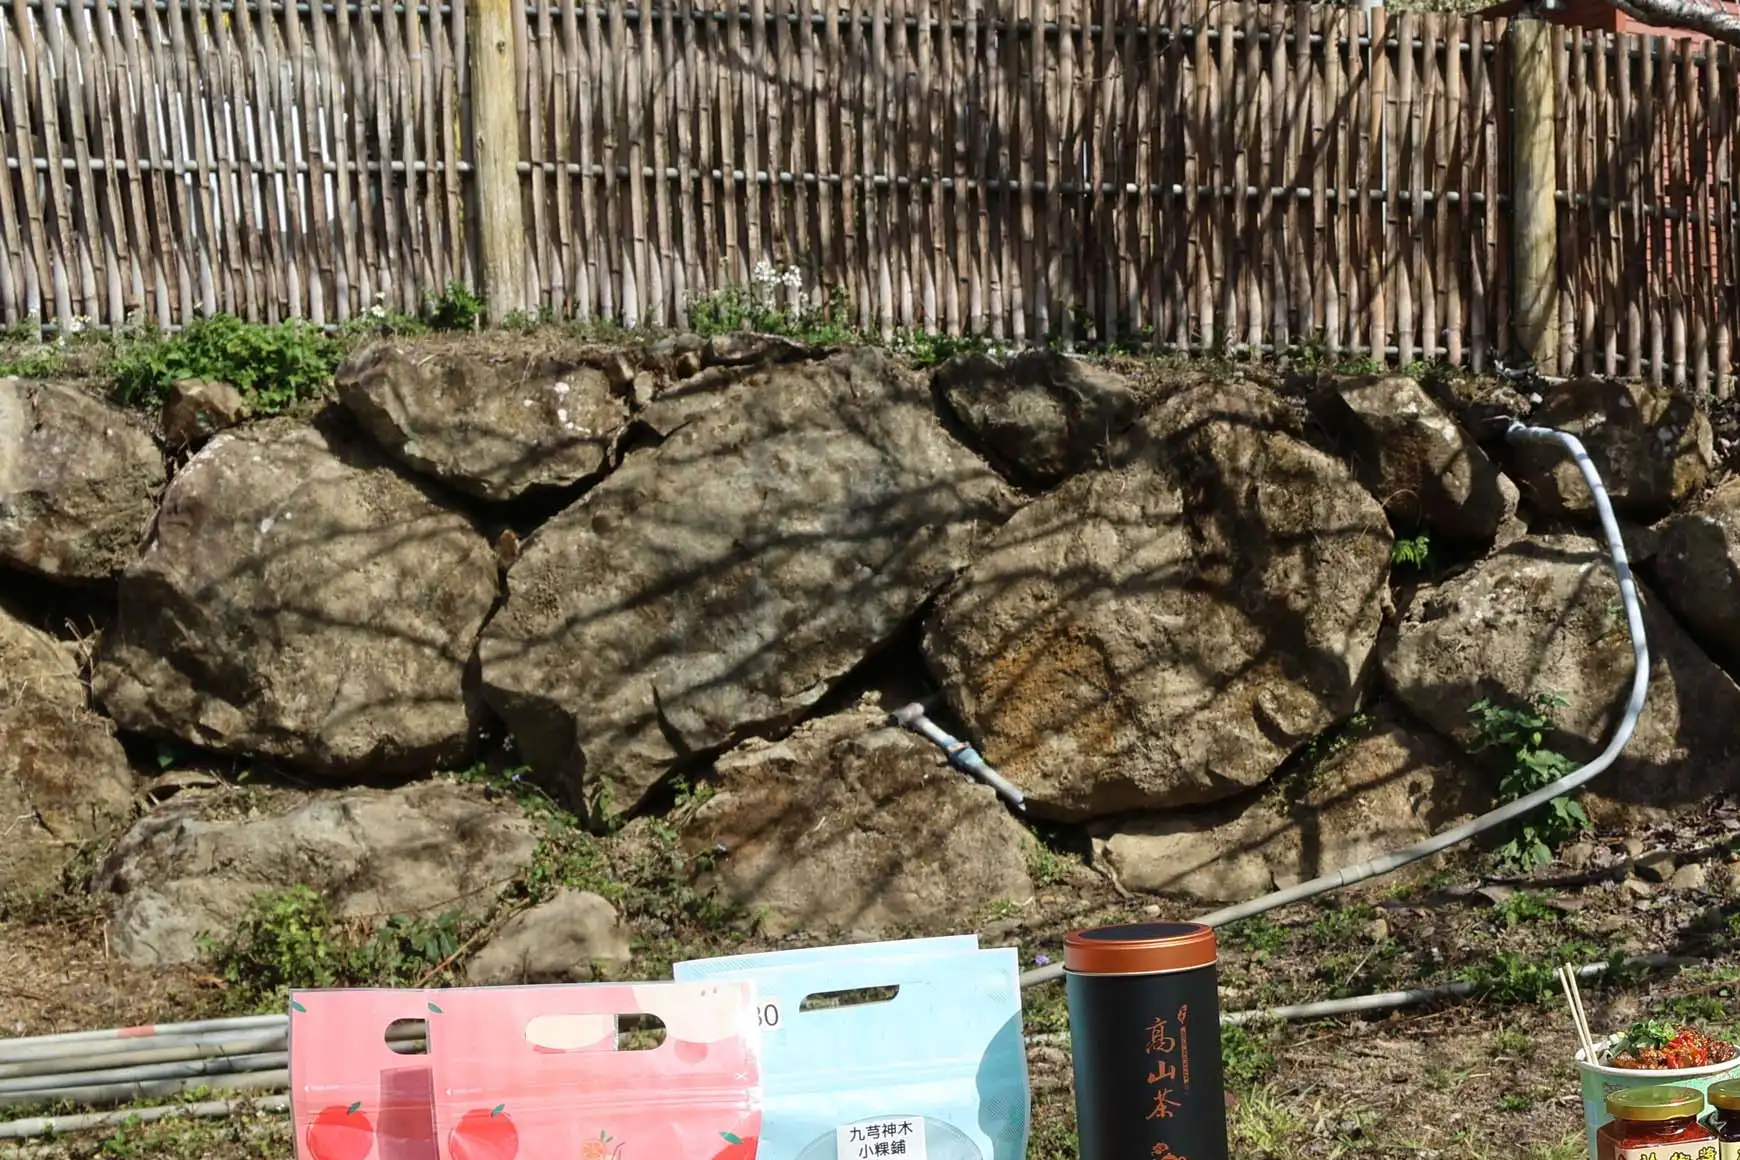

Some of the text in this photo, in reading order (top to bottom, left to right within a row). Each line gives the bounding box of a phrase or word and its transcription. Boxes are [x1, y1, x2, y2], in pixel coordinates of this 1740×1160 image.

[1144, 1016, 1182, 1120] 高山茶
[849, 1120, 913, 1142] 九芎神木
[859, 1139, 906, 1159] 小粿鋪
